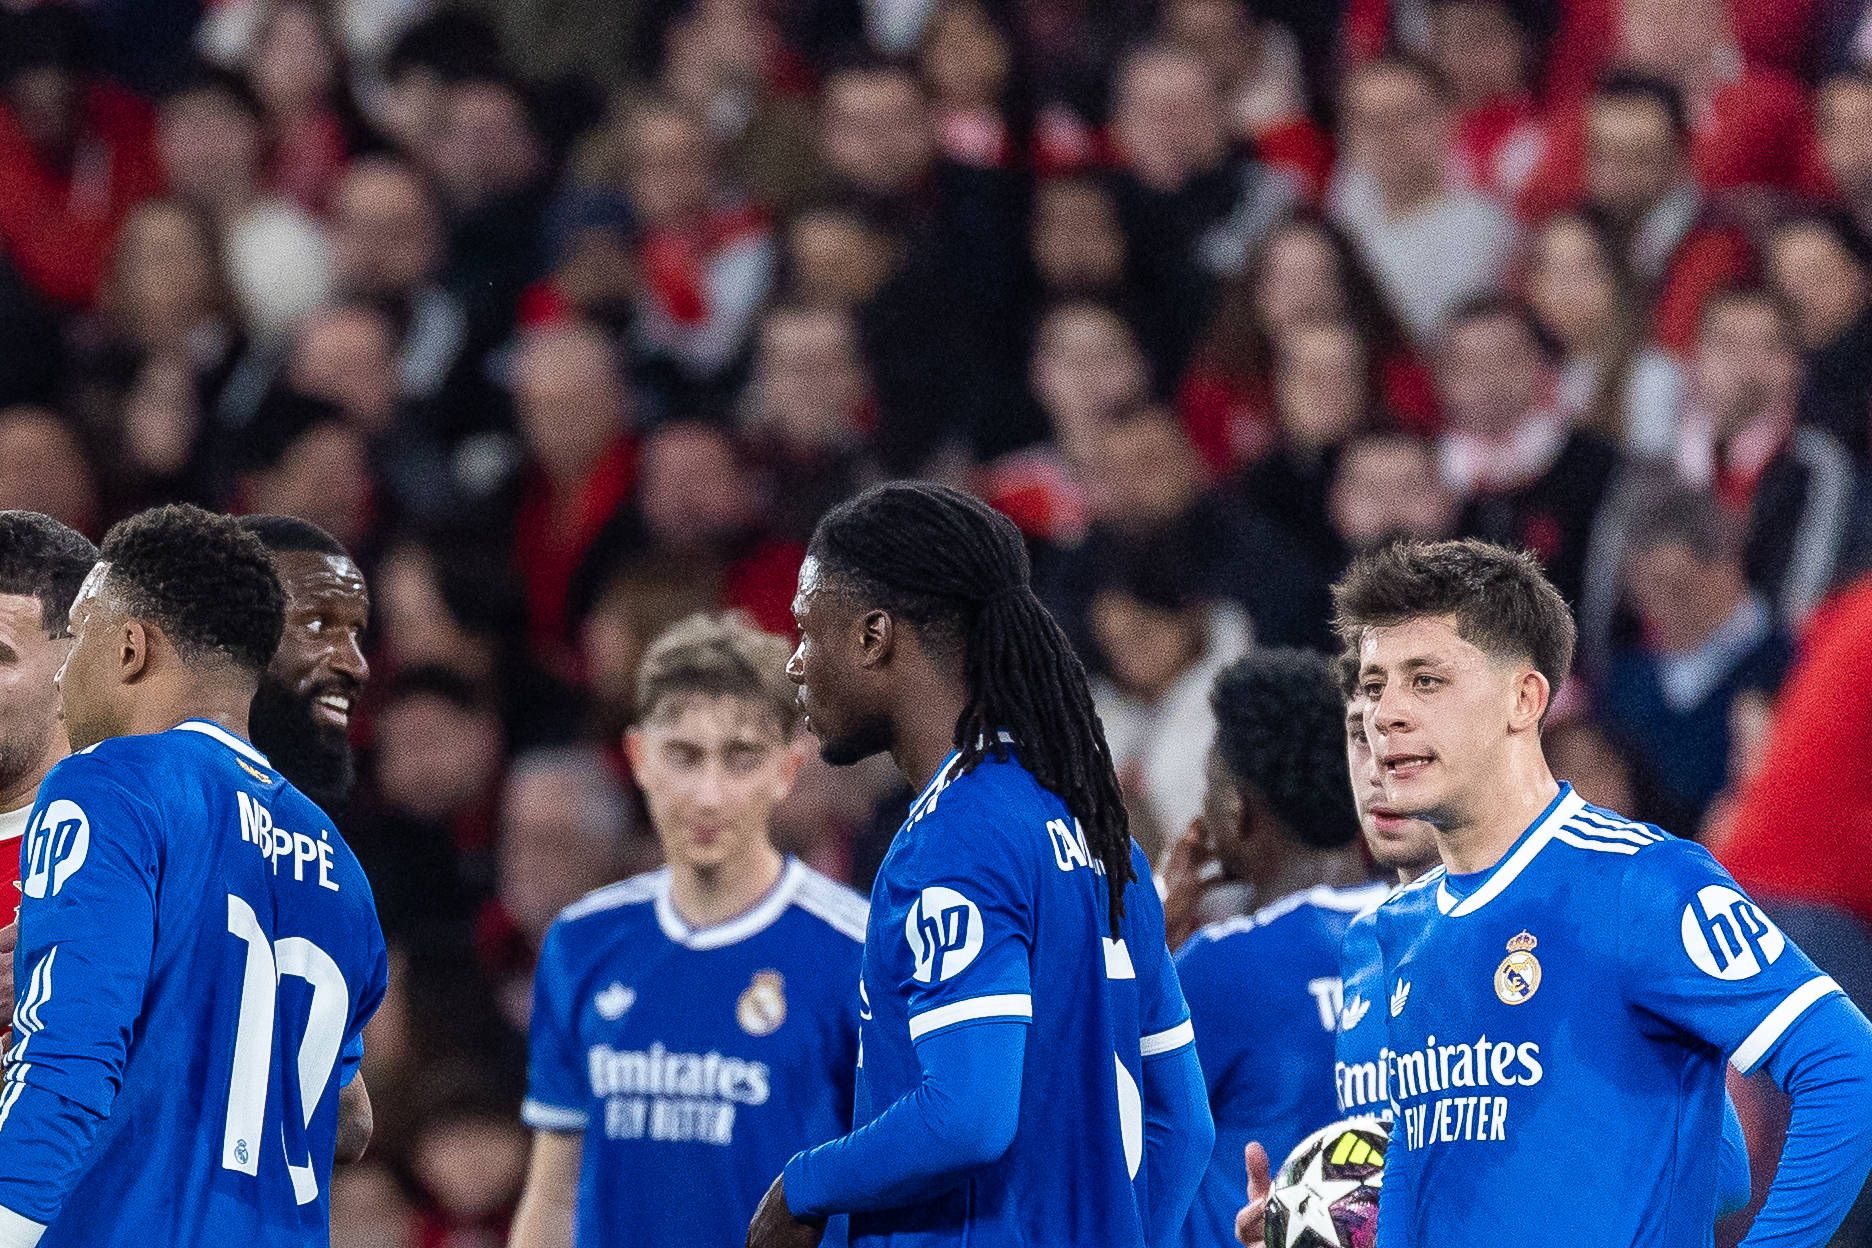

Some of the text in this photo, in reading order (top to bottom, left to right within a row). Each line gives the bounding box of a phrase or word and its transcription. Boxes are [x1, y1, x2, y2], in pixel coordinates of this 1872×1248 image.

[24, 800, 89, 898] hp
[908, 887, 981, 982] hp
[1683, 886, 1783, 980] hp
[1428, 1096, 1508, 1145] ETTER
